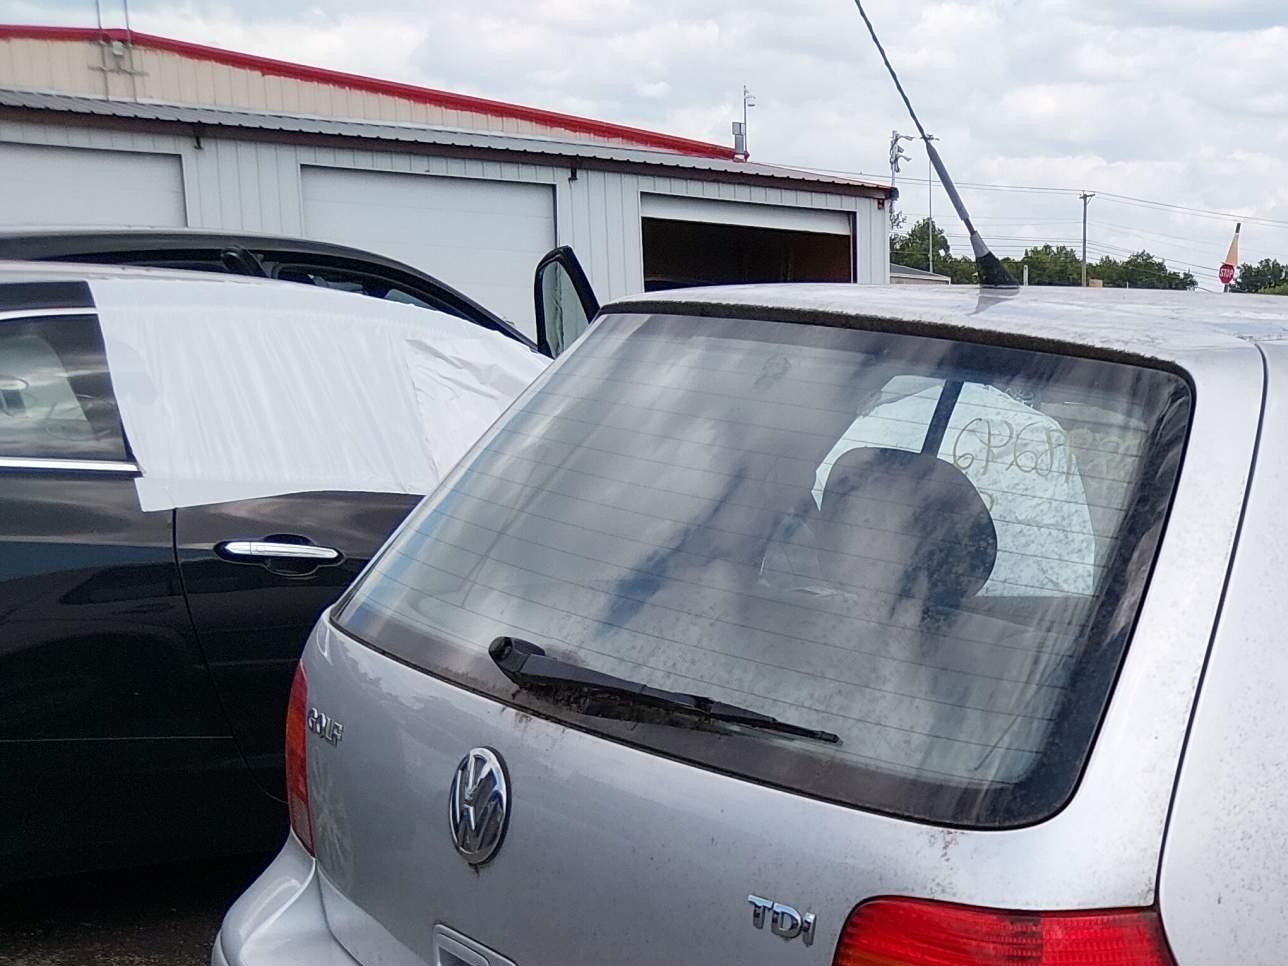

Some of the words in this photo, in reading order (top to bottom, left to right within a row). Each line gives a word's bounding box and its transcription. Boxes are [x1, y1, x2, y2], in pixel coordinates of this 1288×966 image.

[1220, 268, 1234, 278] STOP
[308, 708, 344, 747] GOLF
[747, 894, 816, 948] TDI
